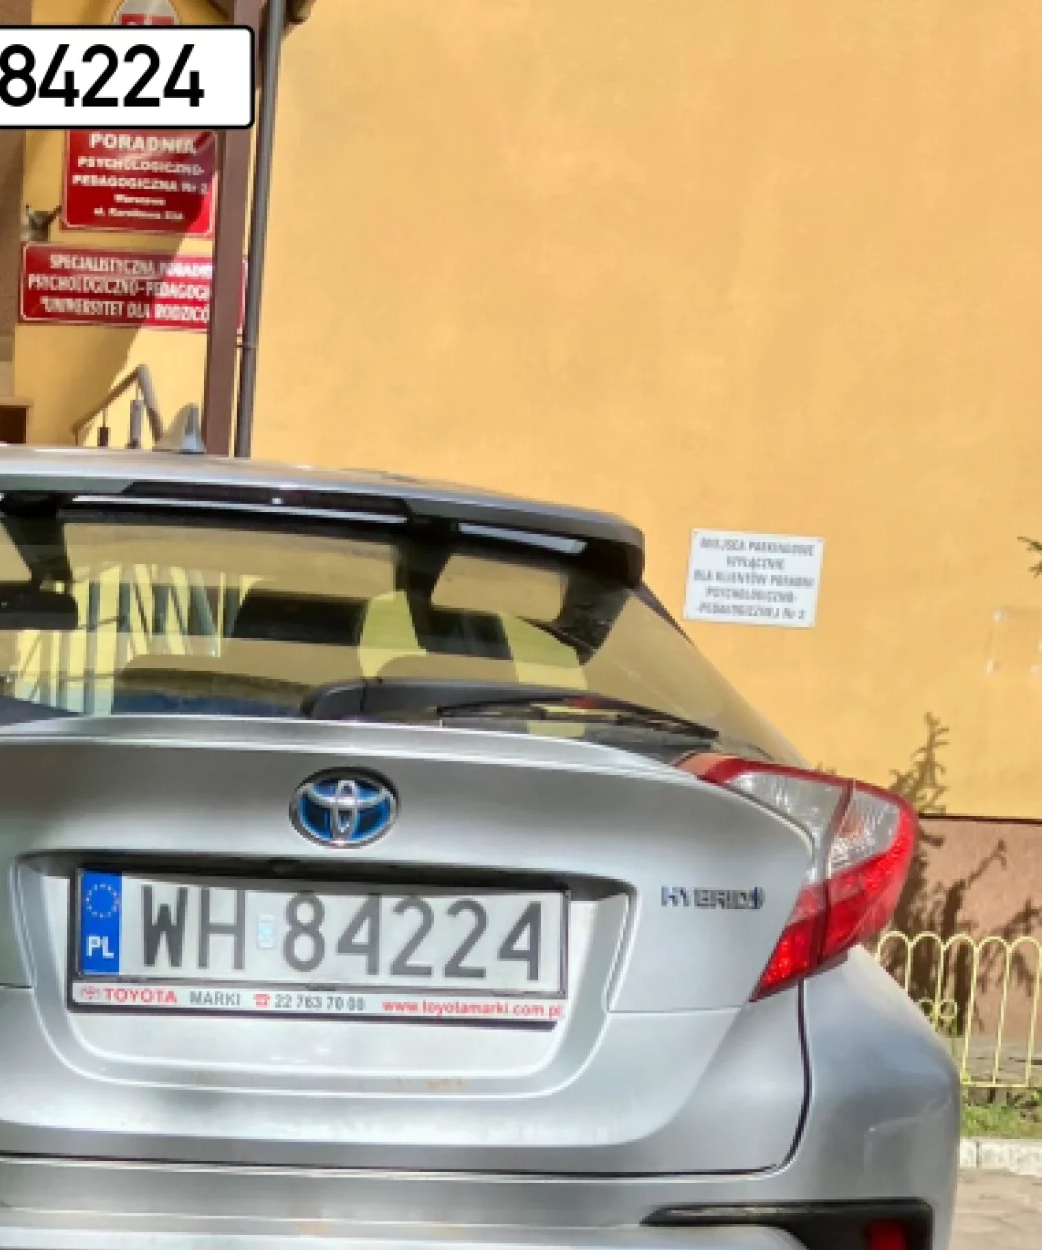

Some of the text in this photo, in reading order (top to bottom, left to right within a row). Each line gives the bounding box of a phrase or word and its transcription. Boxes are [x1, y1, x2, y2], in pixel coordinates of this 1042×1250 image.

[661, 886, 748, 909] HYBRID
[141, 884, 543, 981] WH 84224
[86, 936, 114, 960] PL
[103, 987, 177, 1004] TOYOTA
[189, 990, 240, 1006] MARKI
[275, 993, 292, 1009] 22
